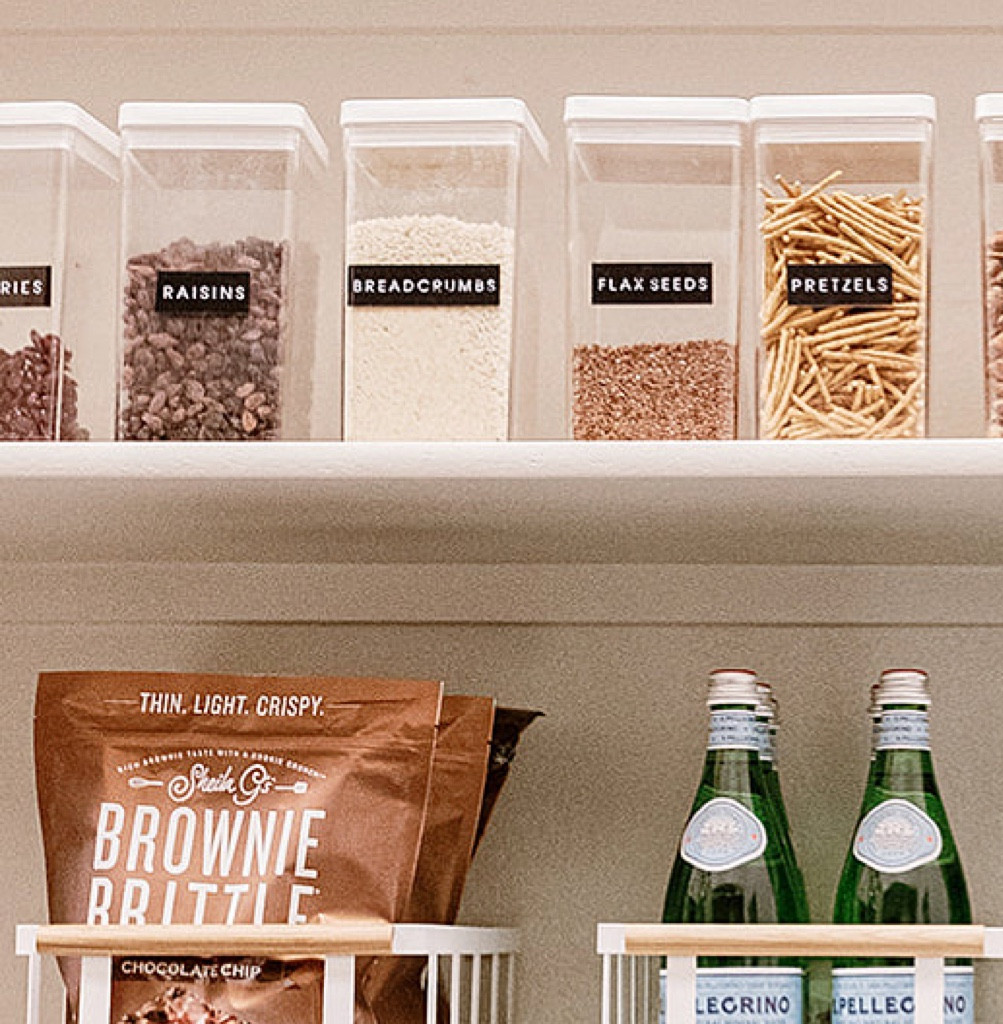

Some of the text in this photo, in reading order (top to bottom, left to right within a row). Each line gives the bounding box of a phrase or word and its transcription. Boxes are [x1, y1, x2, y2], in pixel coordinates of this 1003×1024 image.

[0, 279, 43, 296] RIES
[162, 284, 246, 301] RAISINS
[352, 278, 497, 295] BREADCRUMBS
[597, 276, 709, 293] FLAX SEEDS
[790, 276, 889, 294] PRETZELS
[139, 691, 326, 718] THIN. LIGHT. CRISPY.
[92, 802, 327, 879] BROWNIE
[121, 960, 262, 979] CHOCOLATE CHIP
[695, 996, 791, 1015] LEGRINO
